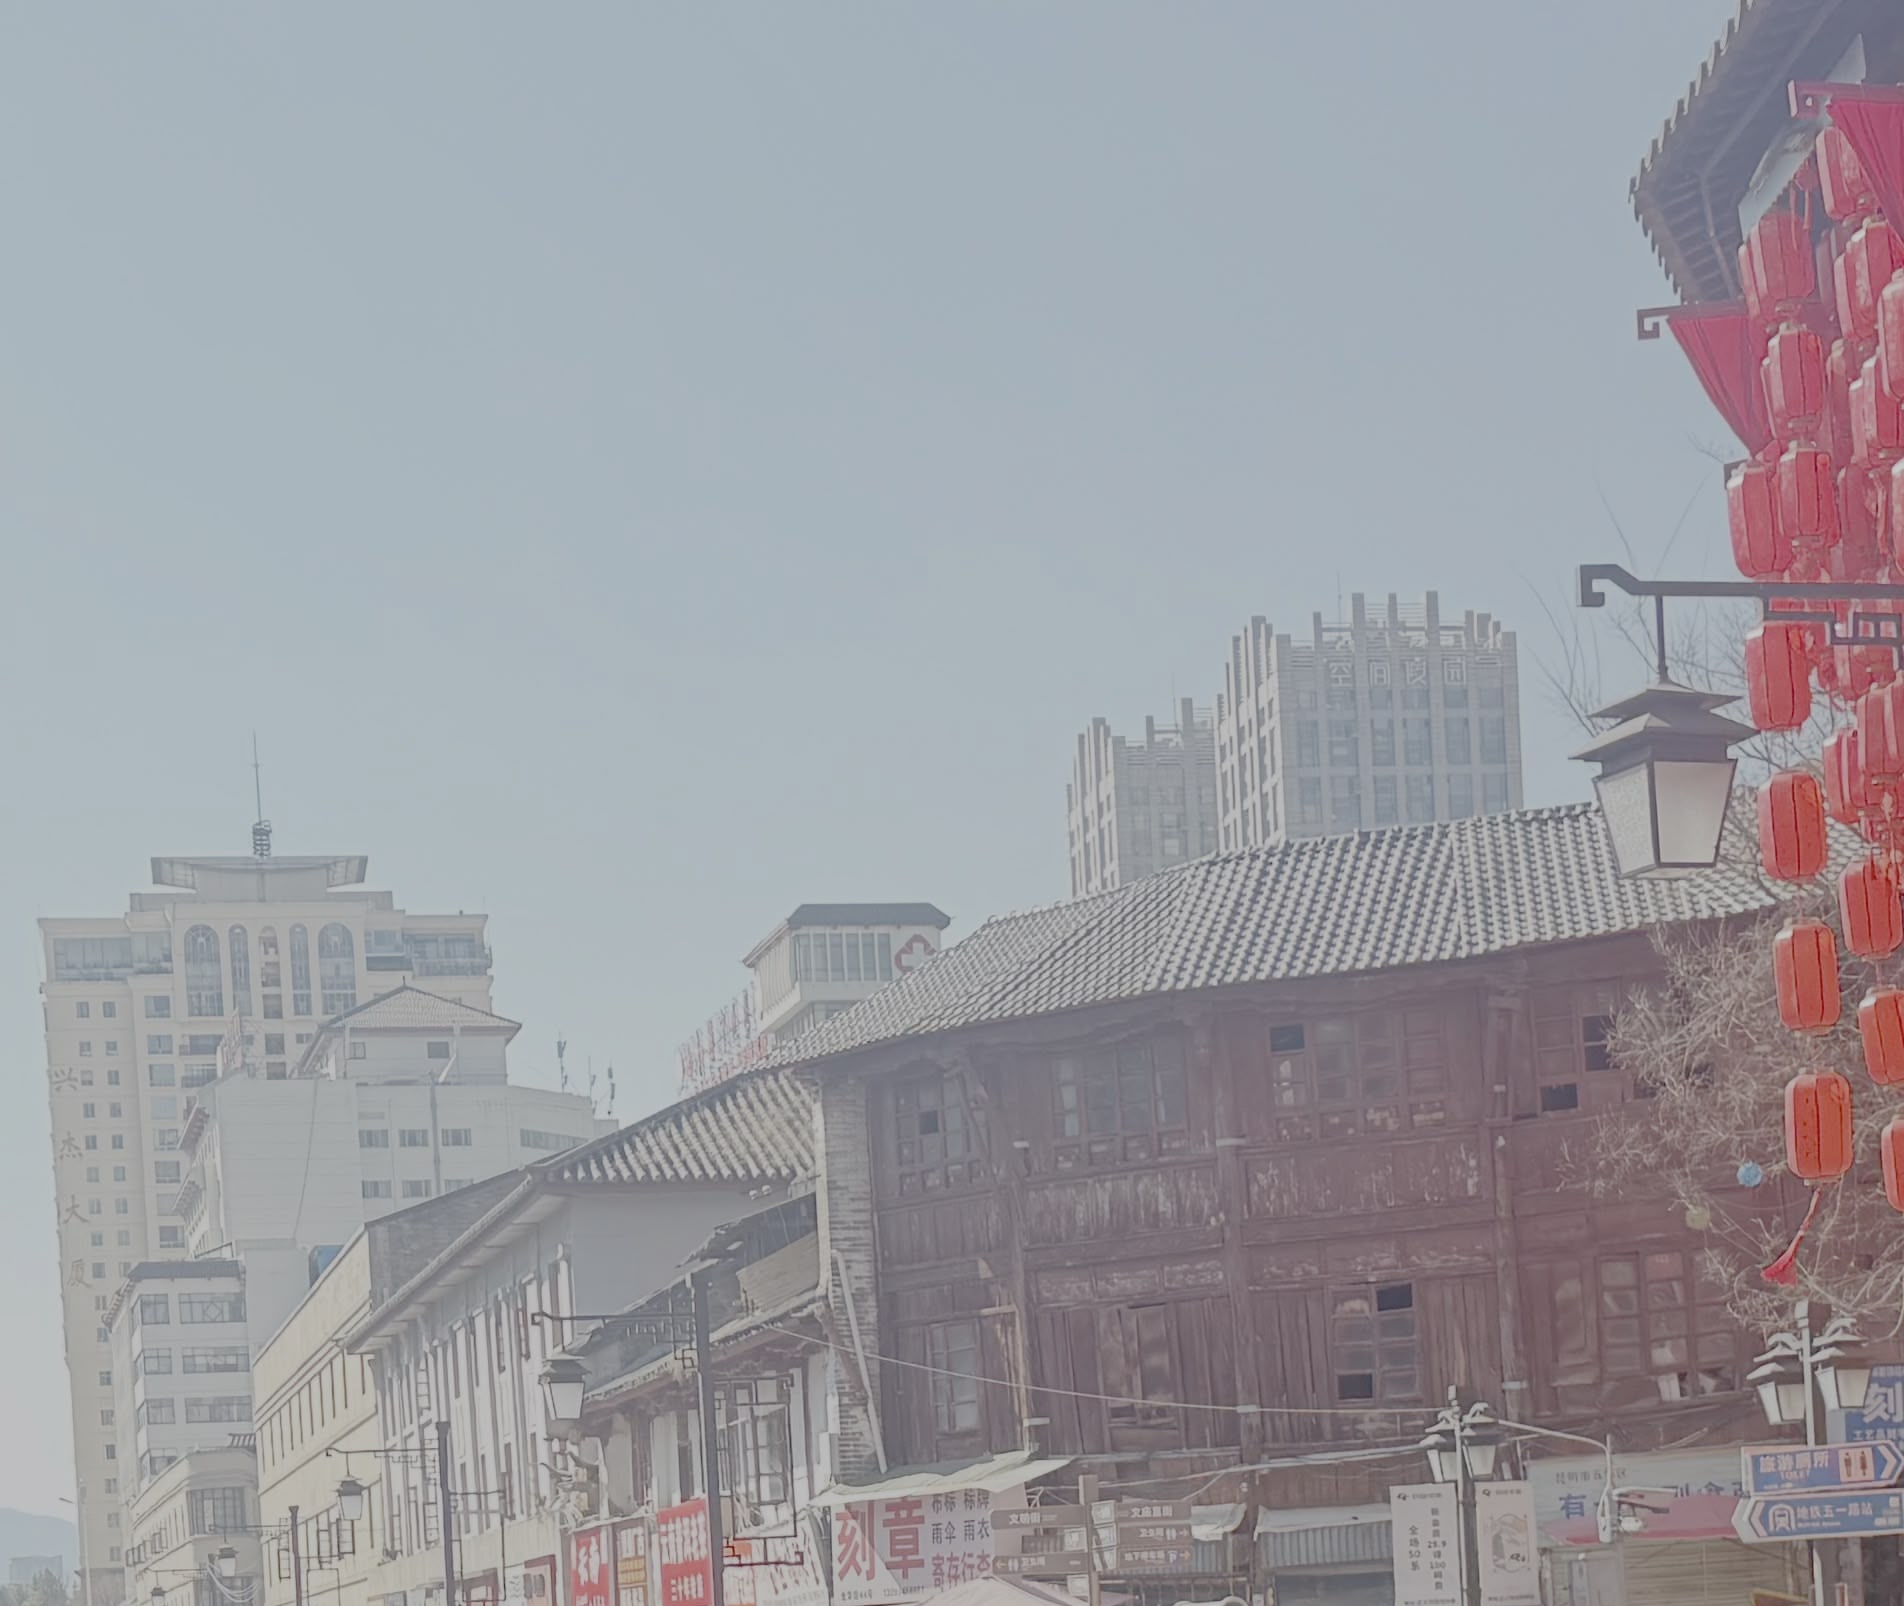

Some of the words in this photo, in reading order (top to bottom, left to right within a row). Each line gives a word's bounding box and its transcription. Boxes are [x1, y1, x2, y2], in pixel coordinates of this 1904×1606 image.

[51, 1066, 93, 1289] 兴杰大厦
[1759, 1451, 1830, 1473] 旅游厕所
[1555, 1468, 1627, 1485] 昆明市五区
[1797, 1502, 1873, 1520] 地铁五一路站
[835, 1495, 925, 1582] 刻章
[931, 1520, 956, 1545] 雨伞
[963, 1517, 990, 1542] 雨衣
